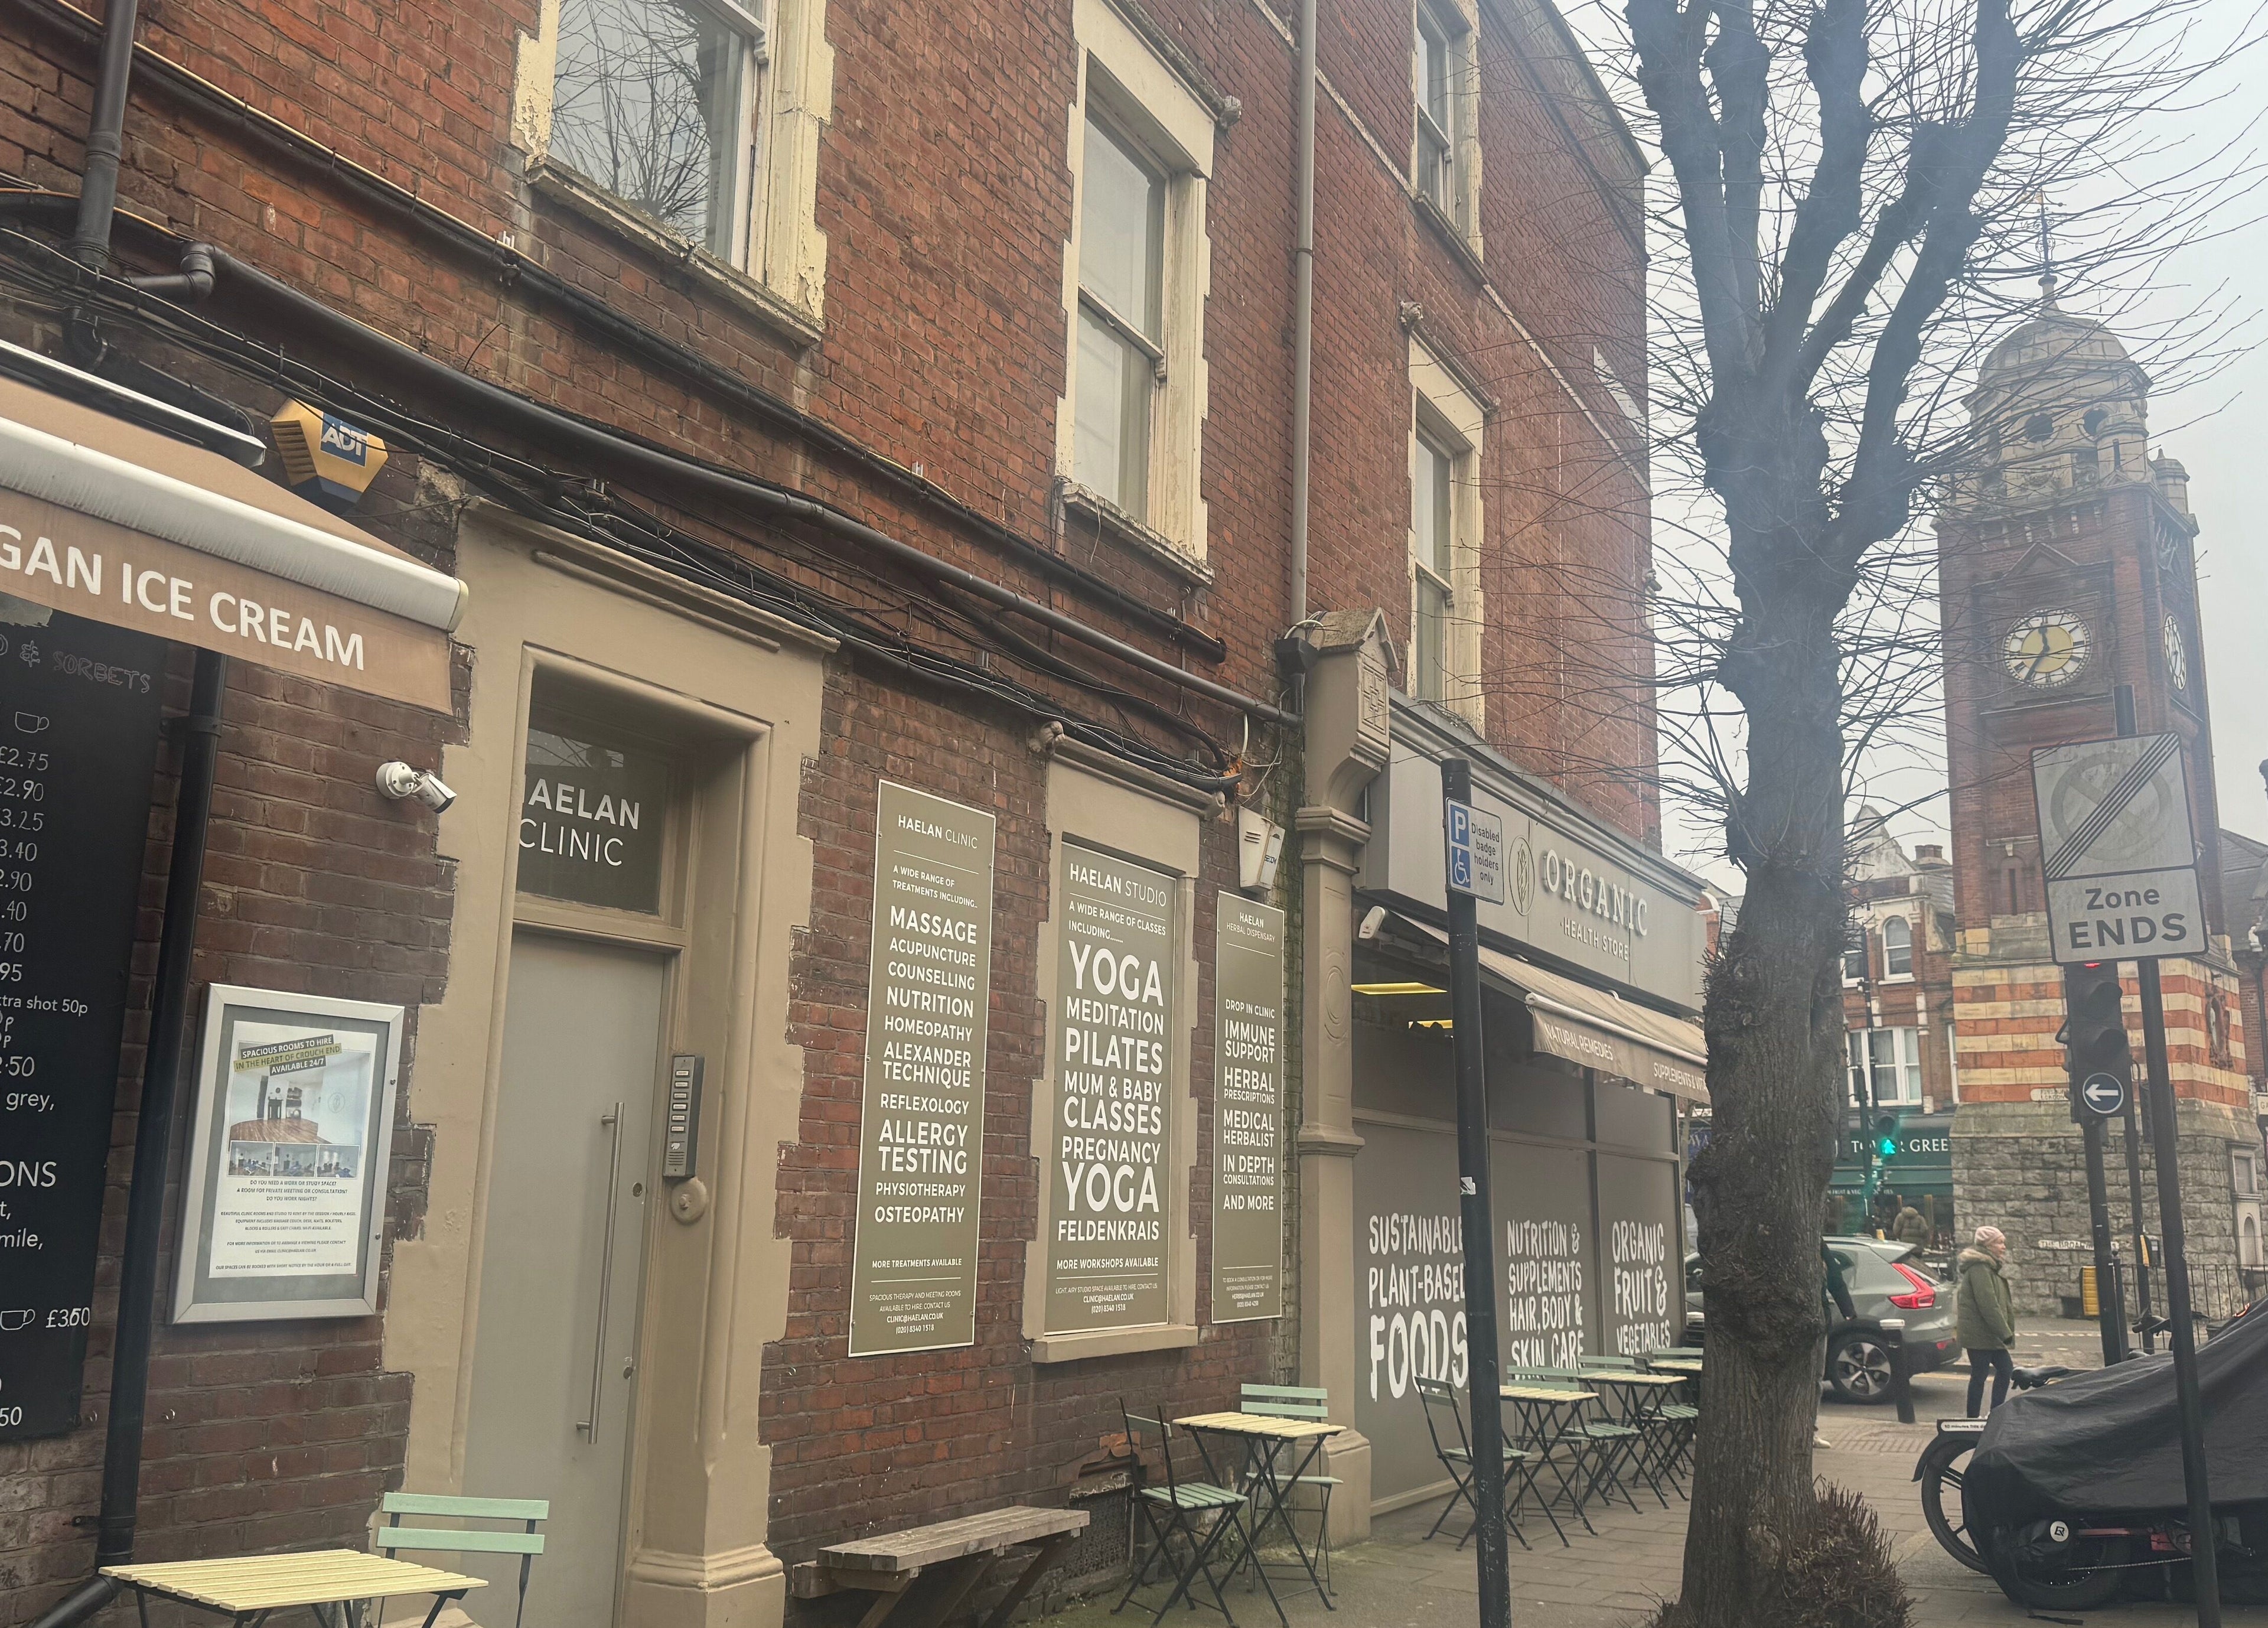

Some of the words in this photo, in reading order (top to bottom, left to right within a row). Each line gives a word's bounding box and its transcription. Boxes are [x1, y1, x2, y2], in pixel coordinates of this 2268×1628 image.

[321, 424, 367, 456] ADT
[0, 524, 102, 595] GAN
[122, 563, 194, 621] ICE
[210, 592, 364, 670] CREAM
[53, 651, 151, 693] SORBETS
[0, 745, 48, 771] £2.75
[528, 778, 640, 830] AELAN
[898, 815, 942, 839] HAELAN
[946, 829, 977, 849] CLINIC
[1455, 810, 1466, 840] P
[1471, 822, 1500, 842] Disabled
[519, 818, 623, 866] CLINIC
[1476, 838, 1495, 856] badge
[1474, 853, 1499, 871] holders
[892, 880, 938, 898] TREATMENTS
[893, 865, 898, 873] A
[901, 866, 919, 878] WIDE
[921, 872, 944, 885] RANGE
[946, 879, 954, 887] OF
[1070, 863, 1121, 894] HAELAN
[1125, 881, 1166, 907] STUDIO
[1480, 871, 1494, 885] only
[1546, 849, 1647, 936] ORGANIC
[2085, 888, 2159, 910] Zone
[890, 906, 976, 944] MASSAGE
[1069, 901, 1075, 911] A
[1077, 902, 1097, 917] WIDE
[1100, 909, 1125, 924] RANGE
[1126, 916, 1136, 927] OF
[1137, 919, 1166, 936] CLASSES
[1240, 912, 1264, 928] HAELAN
[2069, 913, 2186, 949] ENDS
[1227, 922, 1246, 935] HERBAL
[1247, 927, 1275, 943] DISPENSARY
[1564, 917, 1599, 948] HEALTH
[1602, 935, 1629, 961] STORE
[889, 937, 976, 966] ACUPUNCTURE
[888, 961, 975, 991] COUNSELLING
[1068, 940, 1164, 1007] YOGA
[27, 995, 57, 1011] shot
[61, 999, 88, 1017] 50p
[887, 986, 973, 1018] NUTRITION
[1226, 999, 1244, 1012] DROP
[1246, 1004, 1253, 1014] IN
[1254, 1005, 1275, 1018] CLINIC
[885, 1015, 972, 1041] HOMEOPATHY
[1067, 996, 1164, 1036] MEDITATION
[1225, 1019, 1275, 1047] IMMUNE
[1544, 1023, 1579, 1049] NATURAL
[1579, 1036, 1613, 1061] REMEDIES
[242, 1047, 277, 1059] SPACIOUS
[279, 1041, 304, 1053] ROOMS
[317, 1037, 332, 1046] HIRE
[246, 1060, 260, 1069] THE
[261, 1055, 283, 1066] HEART
[296, 1049, 324, 1059] CROUCH
[326, 1046, 340, 1054] END
[884, 1041, 971, 1067] ALEXANDER
[1065, 1027, 1162, 1075] PILATES
[1225, 1040, 1275, 1063] SUPPORT
[271, 1061, 308, 1074] AVAILABLE
[309, 1058, 324, 1067] 24/7
[883, 1061, 970, 1089] TECHNIQUE
[1224, 1066, 1275, 1092] HERBAL
[1654, 1062, 1692, 1087] SUPPLEMENTS
[1064, 1070, 1103, 1096] MUM
[1109, 1076, 1118, 1098] &
[1123, 1077, 1162, 1103] BABY
[1224, 1088, 1275, 1104] PRESCRIPTIONS
[6, 1092, 54, 1112] grey,
[881, 1093, 969, 1115] REFLEXOLOGY
[1064, 1096, 1162, 1135] CLASSES
[1224, 1109, 1274, 1131] MEDICAL
[879, 1119, 968, 1147] ALLERGY
[1224, 1129, 1274, 1147] HERBALIST
[1909, 1138, 1951, 1152] GREE
[878, 1146, 967, 1174] TESTING
[1062, 1135, 1161, 1164] PREGNANCY
[0, 1160, 57, 1187] ONS
[1223, 1154, 1235, 1172] IN
[1239, 1155, 1274, 1174] DEPTH
[876, 1182, 965, 1197] PHYSIOTHERAPY
[1062, 1161, 1159, 1213] YOGA
[1223, 1174, 1274, 1186] CONSULTATIONS
[875, 1206, 964, 1223] OSTEOPATHY
[1223, 1194, 1244, 1210] AND
[1247, 1195, 1274, 1210] MORE
[0, 1227, 43, 1250] mile,
[1058, 1220, 1159, 1241] FELDENKRAIS
[1369, 1213, 1463, 1255] SUSTAINABLE
[1507, 1220, 1567, 1259] NUTRITION
[1572, 1223, 1580, 1254] &
[1612, 1220, 1664, 1265] ORGANIC
[872, 1260, 890, 1268] MORE
[892, 1259, 930, 1268] TREATMENTS
[931, 1258, 962, 1266] AVAILABLE
[1057, 1259, 1078, 1269] MORE
[1080, 1258, 1123, 1269] WORKSHOPS
[1125, 1257, 1158, 1268] AVAILABLE
[1508, 1260, 1582, 1295] SUPPLEMENTS
[1083, 1293, 1134, 1303] CLINIC@HAELAN.CO.UK
[1614, 1266, 1652, 1320] FRUIT
[1655, 1265, 1667, 1316] &
[887, 1313, 943, 1323] CLINIC@HAELAN.CO.UK
[1091, 1305, 1103, 1314] (020)
[1510, 1295, 1540, 1335] HAIR,
[1542, 1293, 1571, 1330] BODY
[1575, 1293, 1583, 1326] &
[896, 1326, 909, 1334] (020)
[1617, 1319, 1670, 1355] VEGETABLES
[1370, 1310, 1469, 1402] FOODS
[1511, 1336, 1545, 1380] SKIN
[1551, 1330, 1585, 1370] CARE
